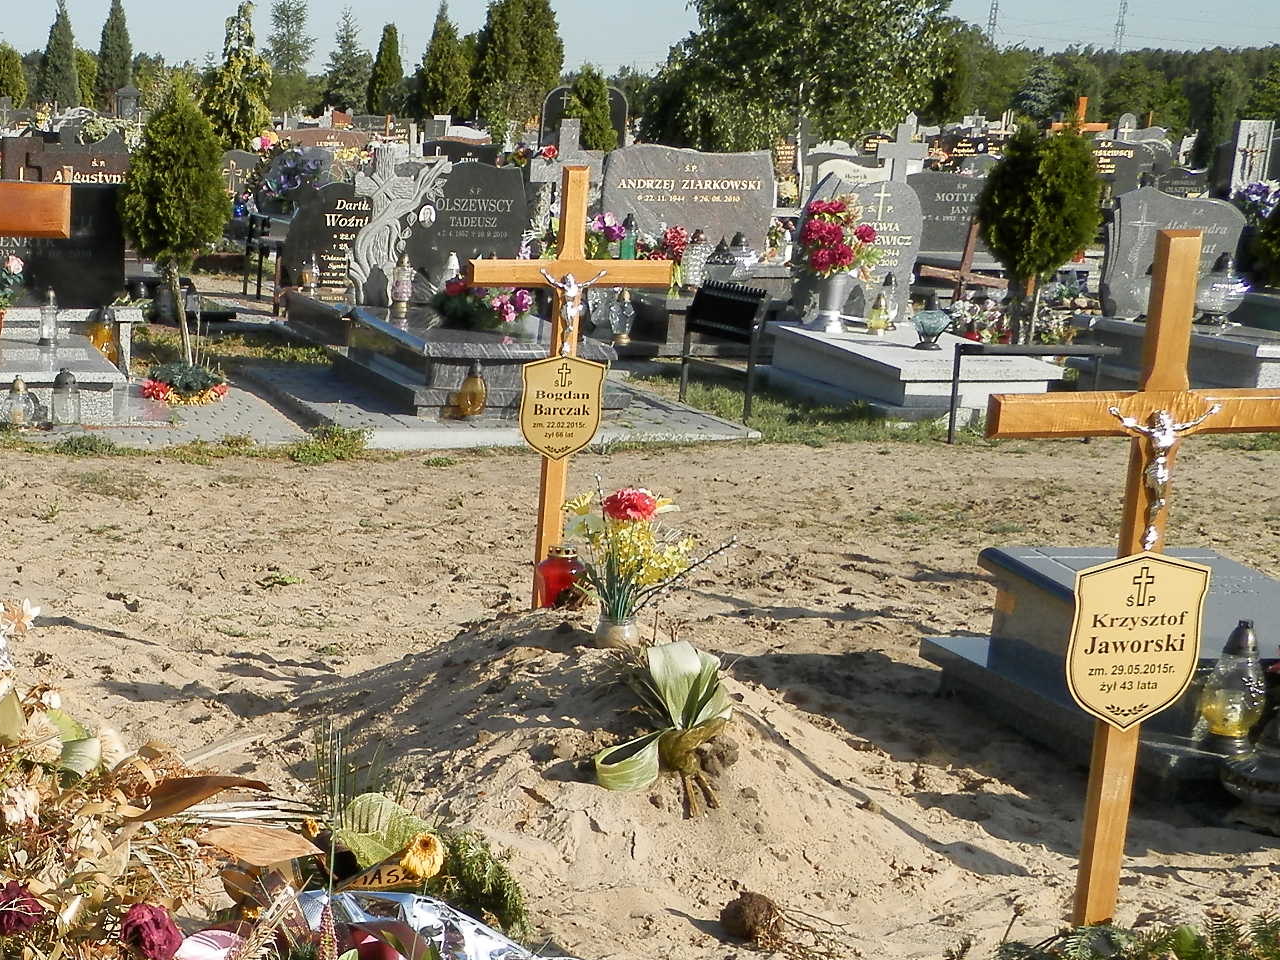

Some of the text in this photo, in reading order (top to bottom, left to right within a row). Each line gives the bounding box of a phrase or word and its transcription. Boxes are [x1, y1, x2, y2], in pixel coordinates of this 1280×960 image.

[618, 178, 762, 191] ANDRZEJ ZIARKOWSKI
[435, 198, 515, 213] OLSZEWSCY
[449, 216, 498, 228] TADEUSZ
[535, 390, 590, 401] Bogdan
[533, 403, 591, 416] Barczak
[1147, 595, 1156, 606] P
[1092, 610, 1189, 631] Krzysztof
[1084, 633, 1186, 655] Jaworski
[1088, 663, 1176, 676] zm. 29.05.2015r.
[1120, 680, 1134, 691] 43
[1137, 680, 1158, 691] lata
